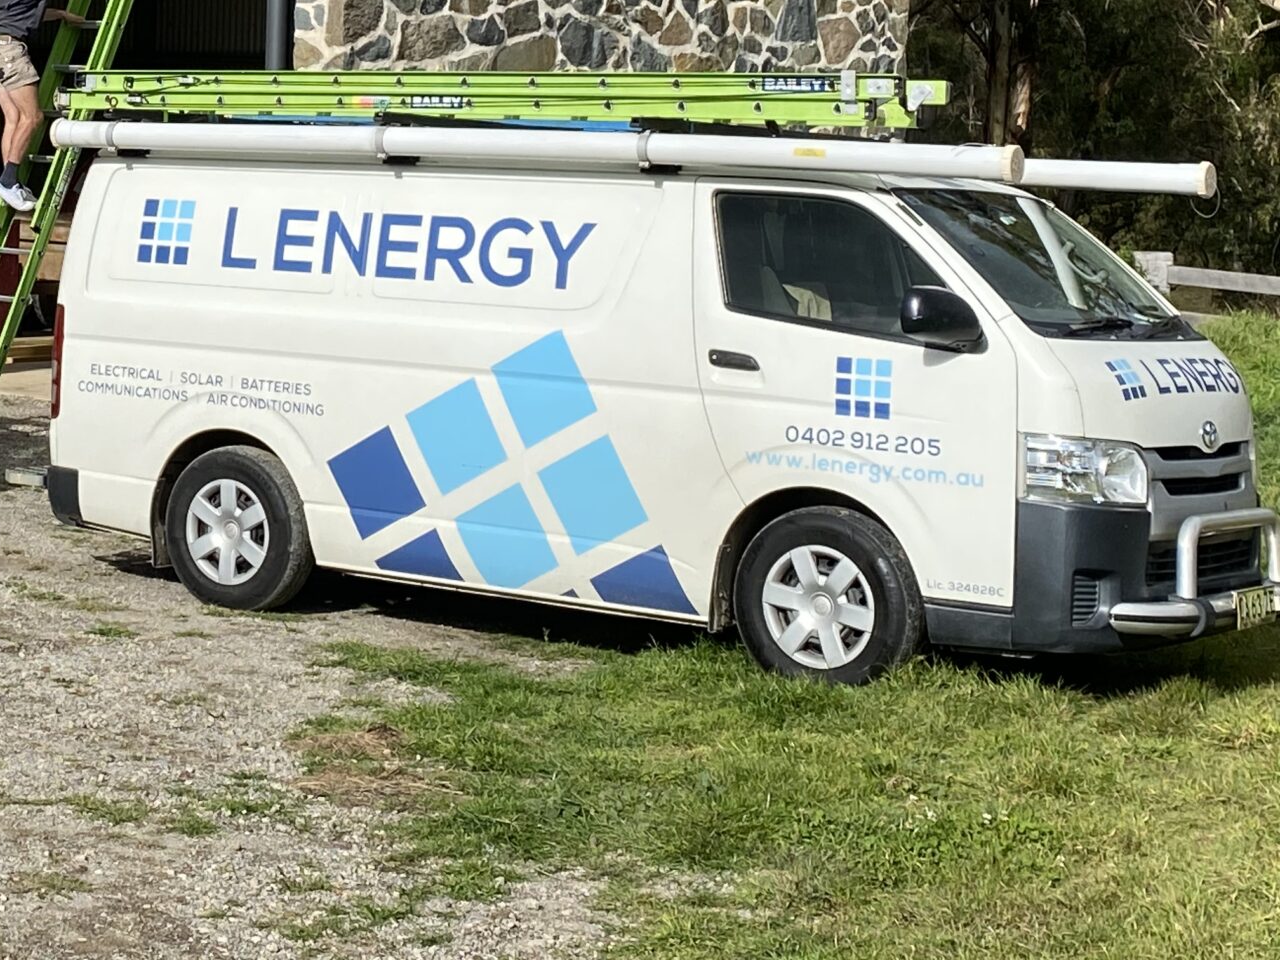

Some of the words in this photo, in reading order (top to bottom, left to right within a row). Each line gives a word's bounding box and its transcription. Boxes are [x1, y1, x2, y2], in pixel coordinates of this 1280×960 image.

[763, 78, 823, 91] BAILEY
[412, 96, 462, 108] BAILEY
[221, 206, 598, 290] LENERGY
[78, 380, 189, 402] COMMUNICATIONS
[90, 363, 163, 382] ELECTRICAL
[180, 372, 223, 387] SOLAR
[240, 378, 312, 396] BATTERIES
[785, 425, 845, 447] 0402
[851, 431, 889, 452] 912
[895, 436, 941, 456] 205
[746, 450, 984, 487] www.lenergy.com.au
